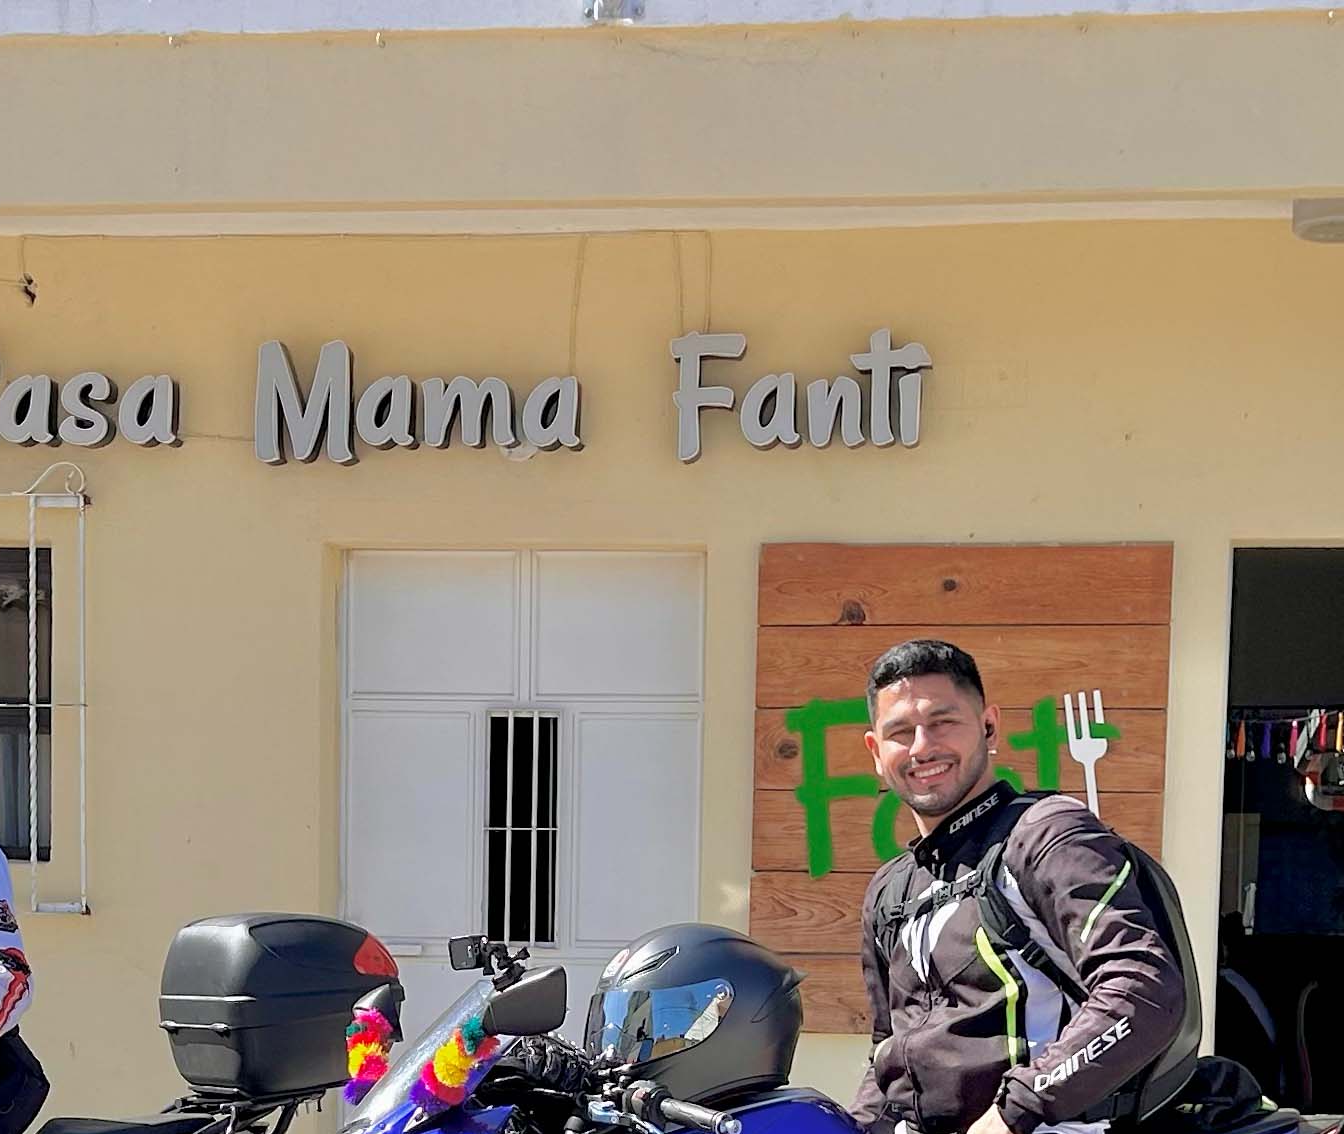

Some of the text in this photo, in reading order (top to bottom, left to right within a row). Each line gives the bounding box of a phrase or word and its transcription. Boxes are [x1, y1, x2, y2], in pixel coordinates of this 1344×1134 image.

[256, 339, 582, 465] Mama
[670, 327, 933, 461] Fanti
[949, 792, 999, 834] DAINESE
[1033, 1016, 1132, 1093] DAINESE
